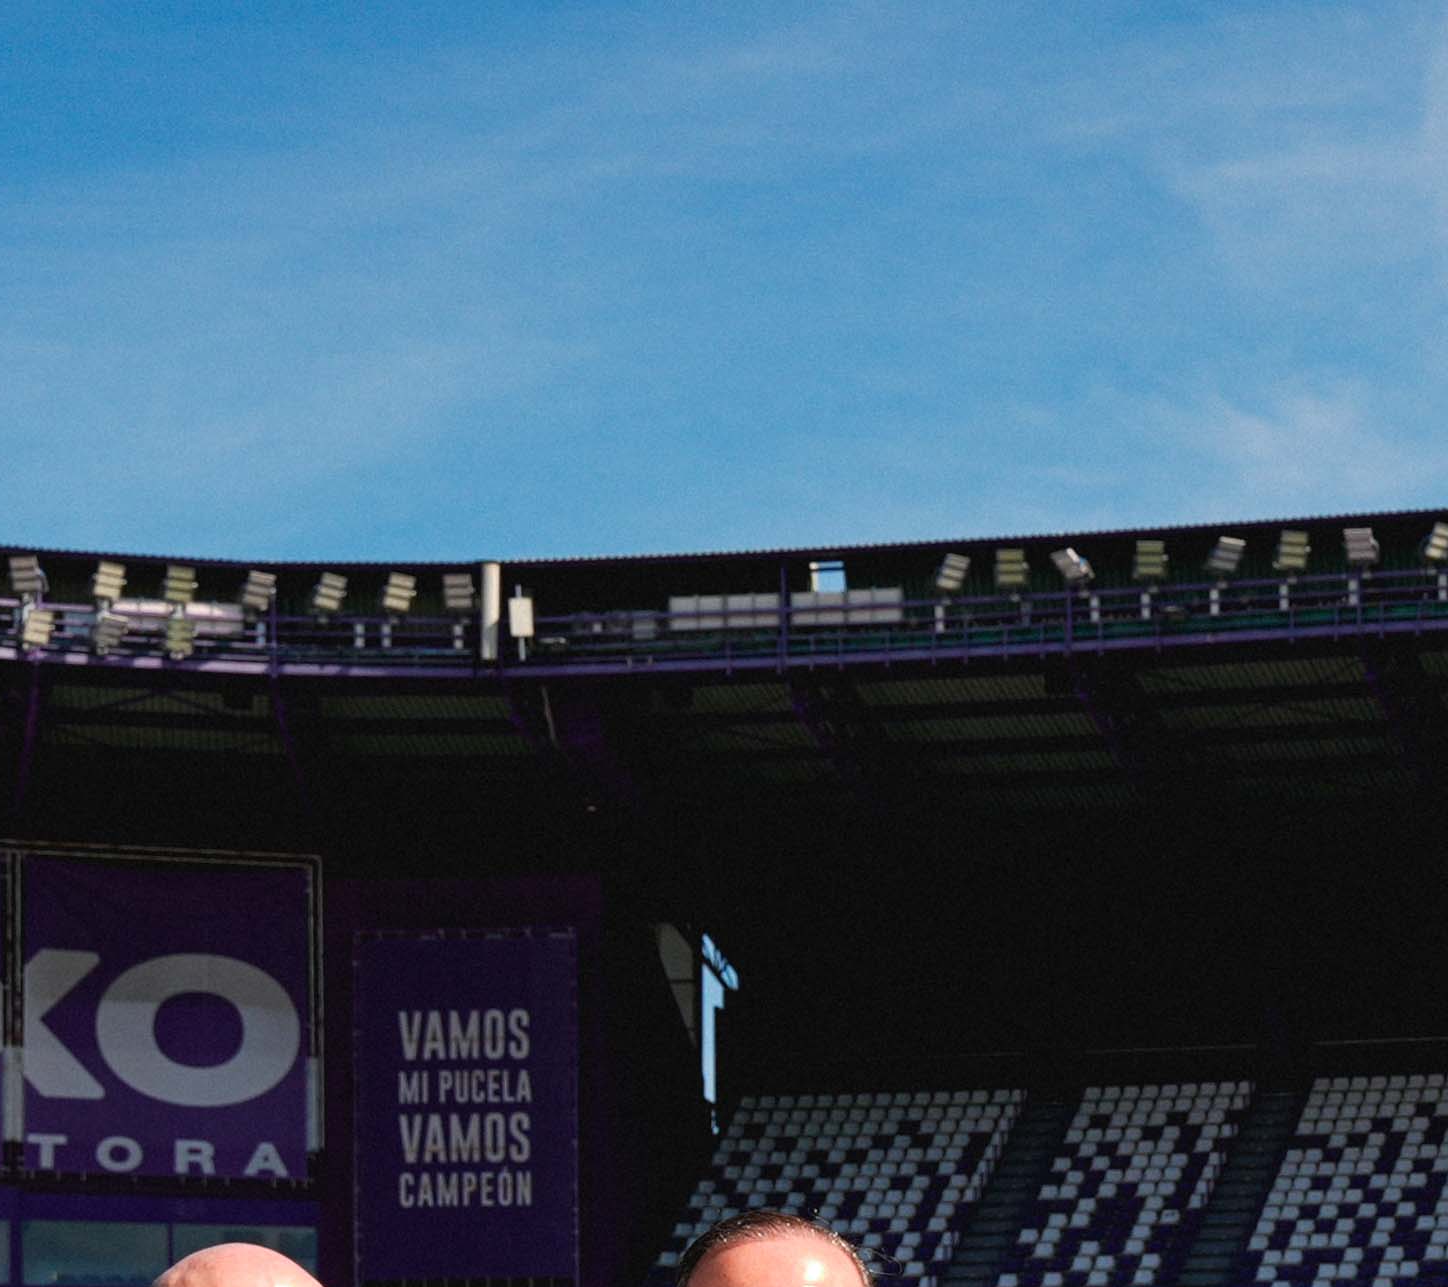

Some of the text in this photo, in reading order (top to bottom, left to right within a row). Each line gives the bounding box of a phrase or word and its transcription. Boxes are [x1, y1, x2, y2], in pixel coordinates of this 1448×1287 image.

[398, 1008, 531, 1061] VAMOS
[398, 1070, 532, 1104] MI PUCELA
[399, 1112, 531, 1165] VAMOS
[399, 1166, 533, 1209] CAMPEÓN
